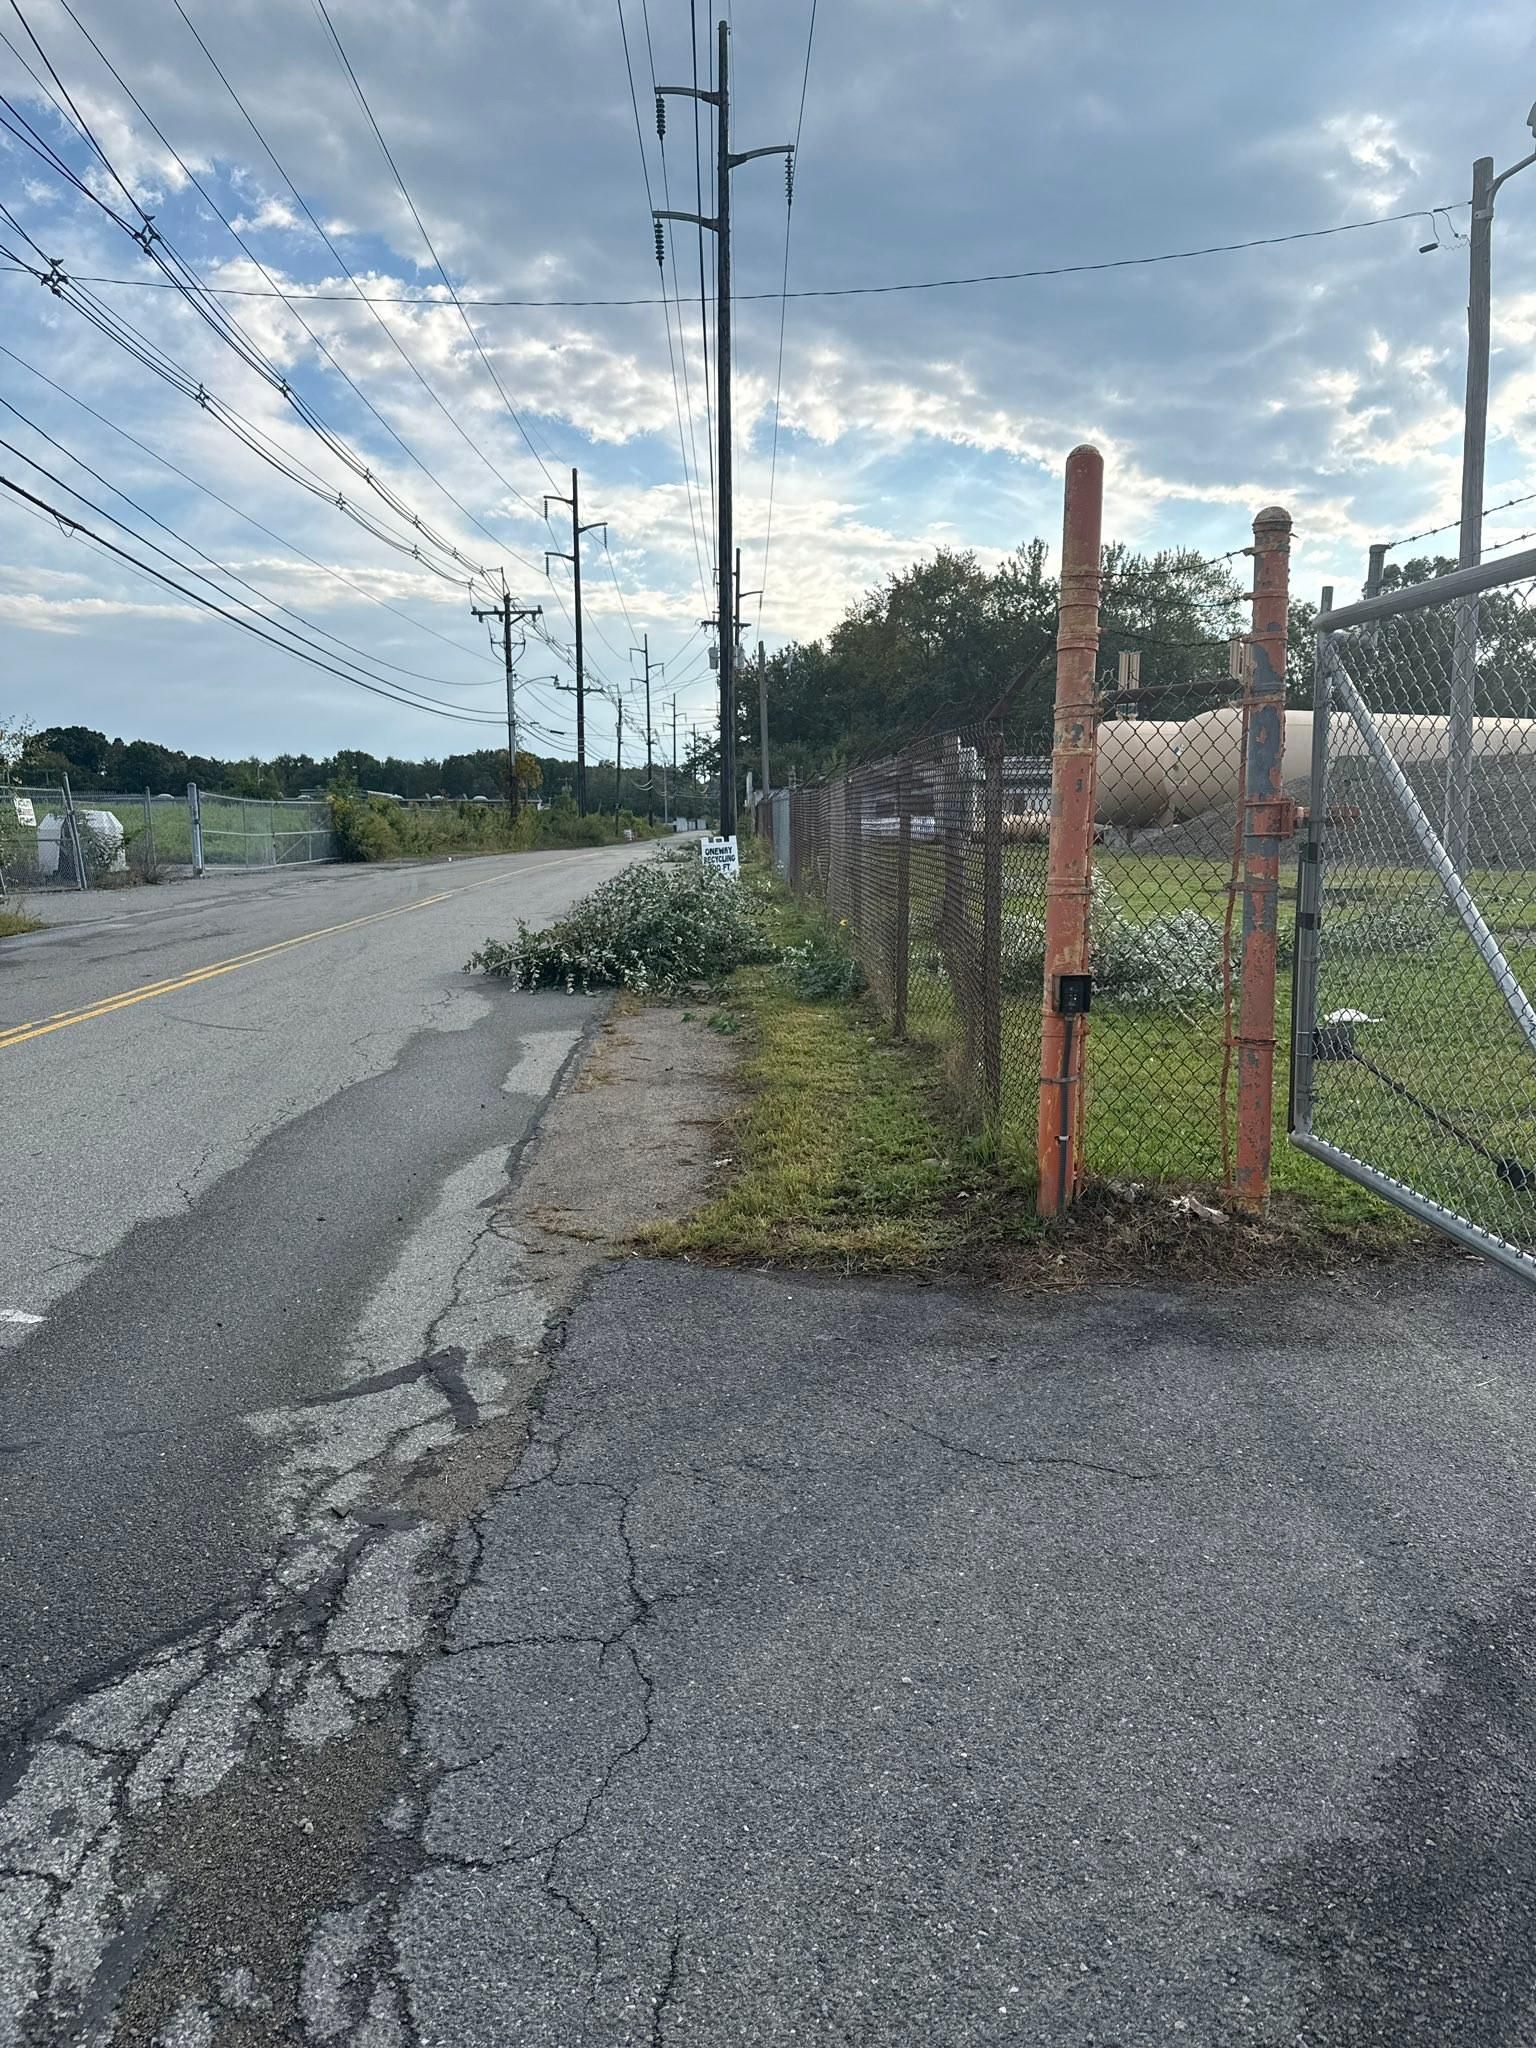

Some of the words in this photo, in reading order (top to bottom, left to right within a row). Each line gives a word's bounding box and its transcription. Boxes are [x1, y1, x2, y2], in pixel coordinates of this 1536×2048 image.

[705, 847, 732, 855] ONEWAY
[704, 855, 736, 864] RECYCLING
[723, 864, 730, 872] FT
